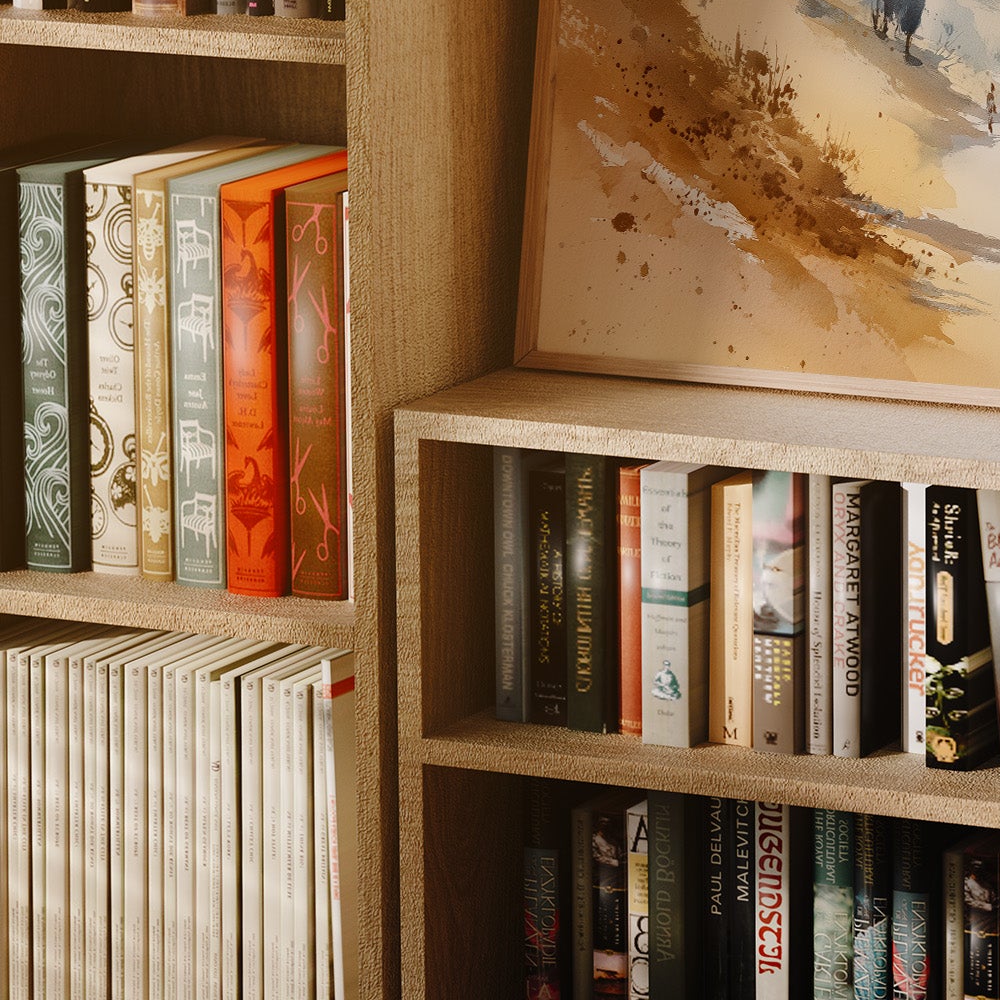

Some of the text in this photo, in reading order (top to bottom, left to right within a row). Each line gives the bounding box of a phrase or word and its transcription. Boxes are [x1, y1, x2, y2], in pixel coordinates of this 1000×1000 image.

[650, 538, 681, 549] Theory
[649, 570, 681, 582] Fiction
[834, 492, 846, 669] ORYX AND CRAKE
[846, 493, 860, 697] MARGARET ATWOOD
[813, 591, 822, 622] House
[502, 610, 514, 691] KLOSTERMAN
[812, 624, 822, 638] of
[908, 605, 926, 697] rucker
[812, 641, 822, 690] Splendid
[723, 726, 739, 740] M
[812, 693, 822, 739] Isolation
[710, 799, 722, 915] PAUL DELVAU
